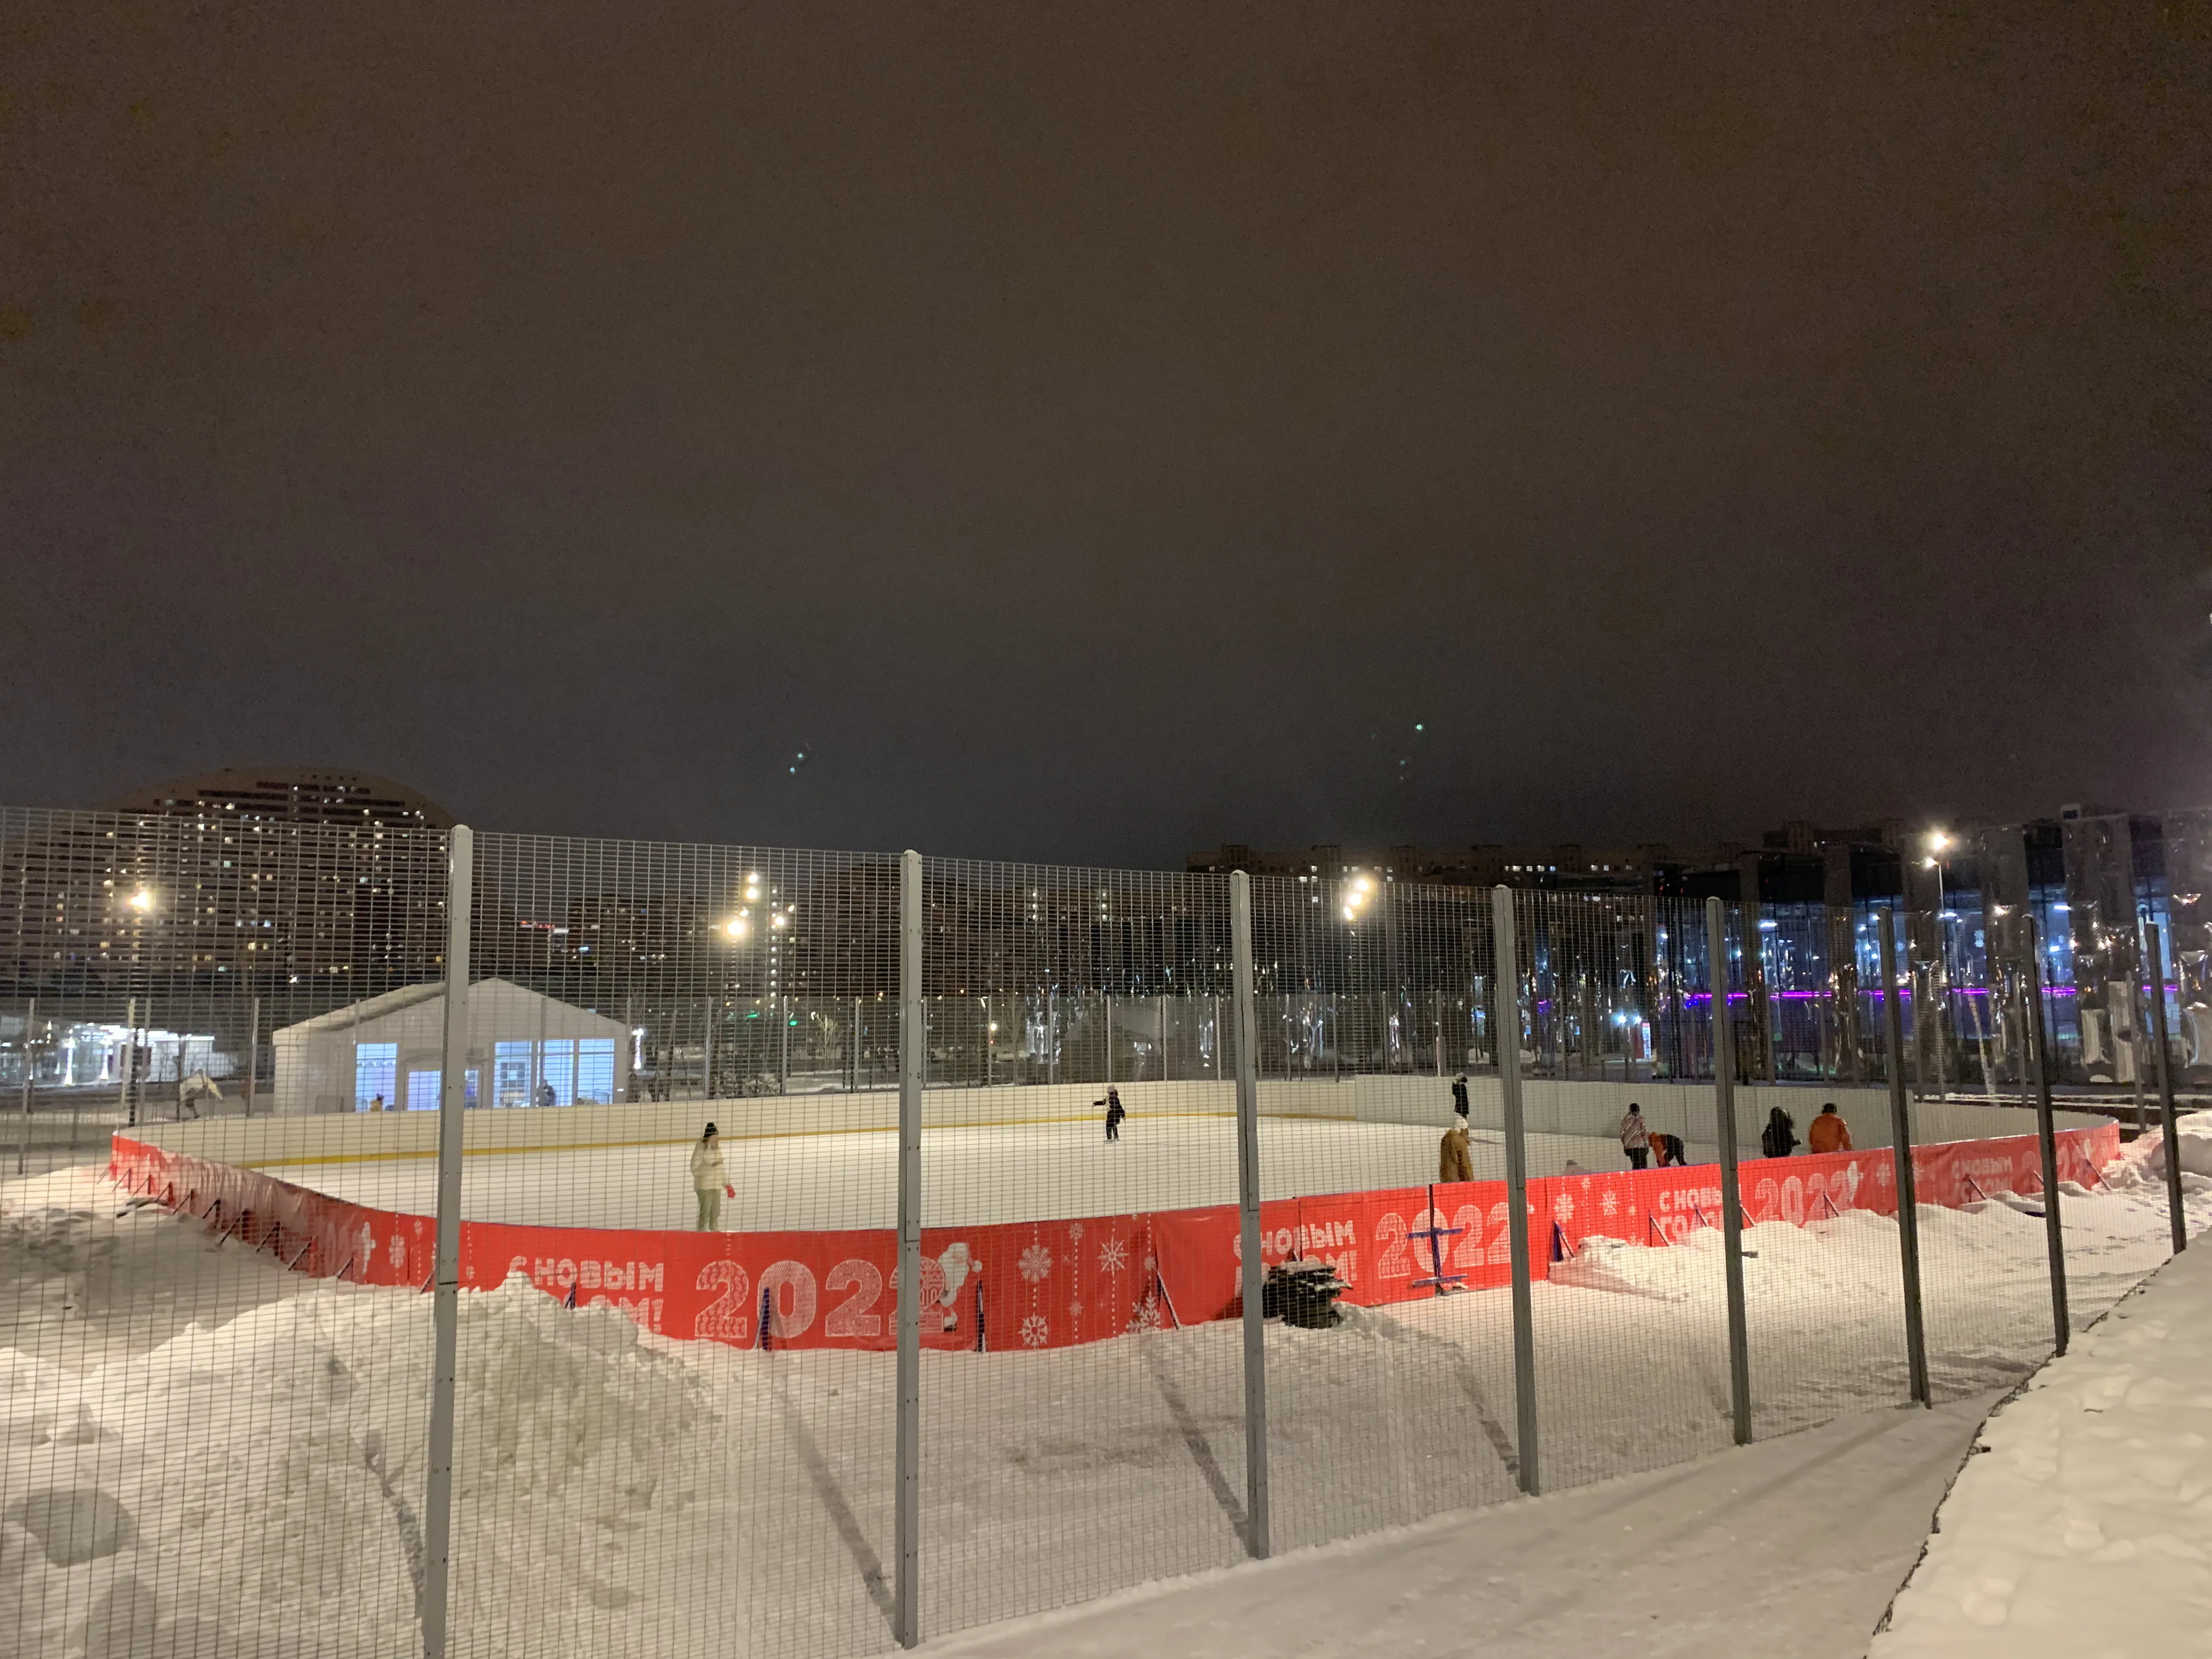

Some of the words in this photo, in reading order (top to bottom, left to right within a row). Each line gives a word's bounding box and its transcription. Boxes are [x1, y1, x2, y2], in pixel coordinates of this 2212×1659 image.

[1659, 1191, 1671, 1212] С
[1674, 1184, 1741, 1210] НОВЫ
[1260, 1220, 1356, 1256] НОВЫМ
[534, 1257, 664, 1292] НОВЫМ
[695, 1257, 946, 1339] 2022
